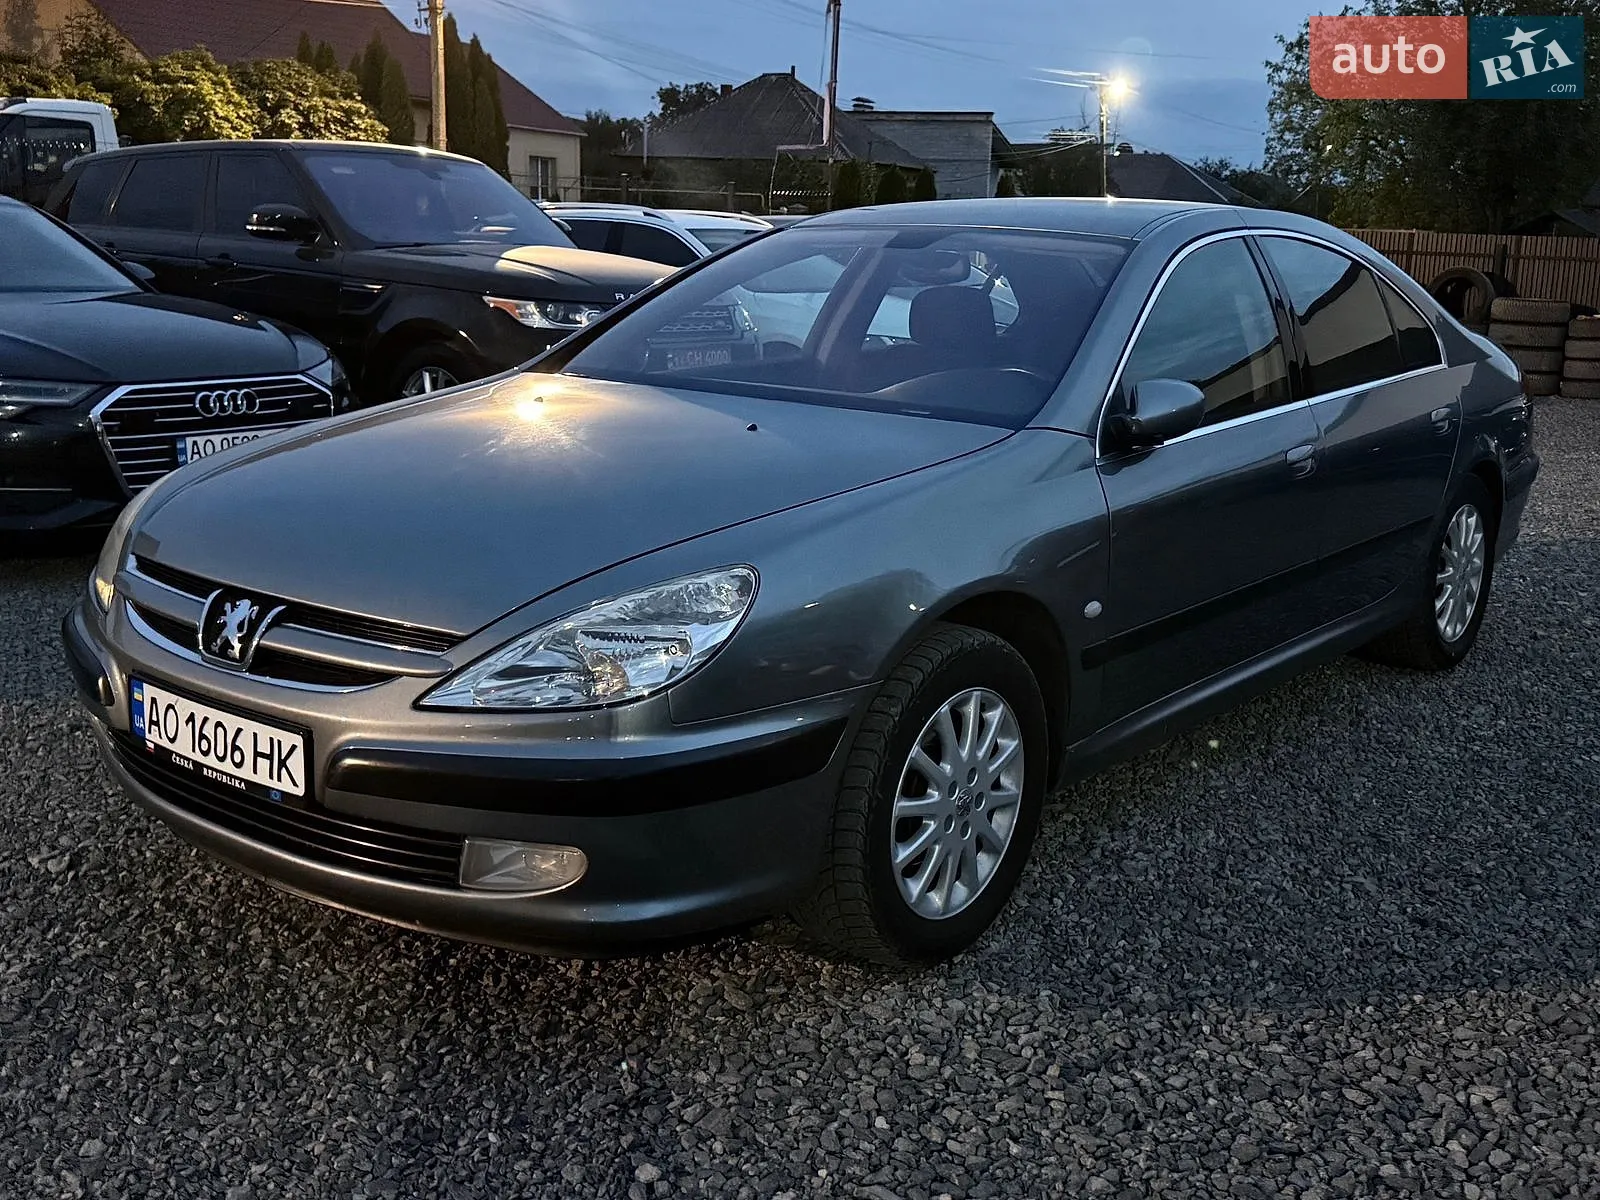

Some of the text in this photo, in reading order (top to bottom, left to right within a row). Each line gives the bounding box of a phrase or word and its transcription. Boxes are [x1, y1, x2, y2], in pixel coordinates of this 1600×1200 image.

[134, 713, 145, 730] UA
[147, 696, 300, 789] AO 1606 HK
[171, 752, 247, 791] ČESKÁ REPUBLIKA
